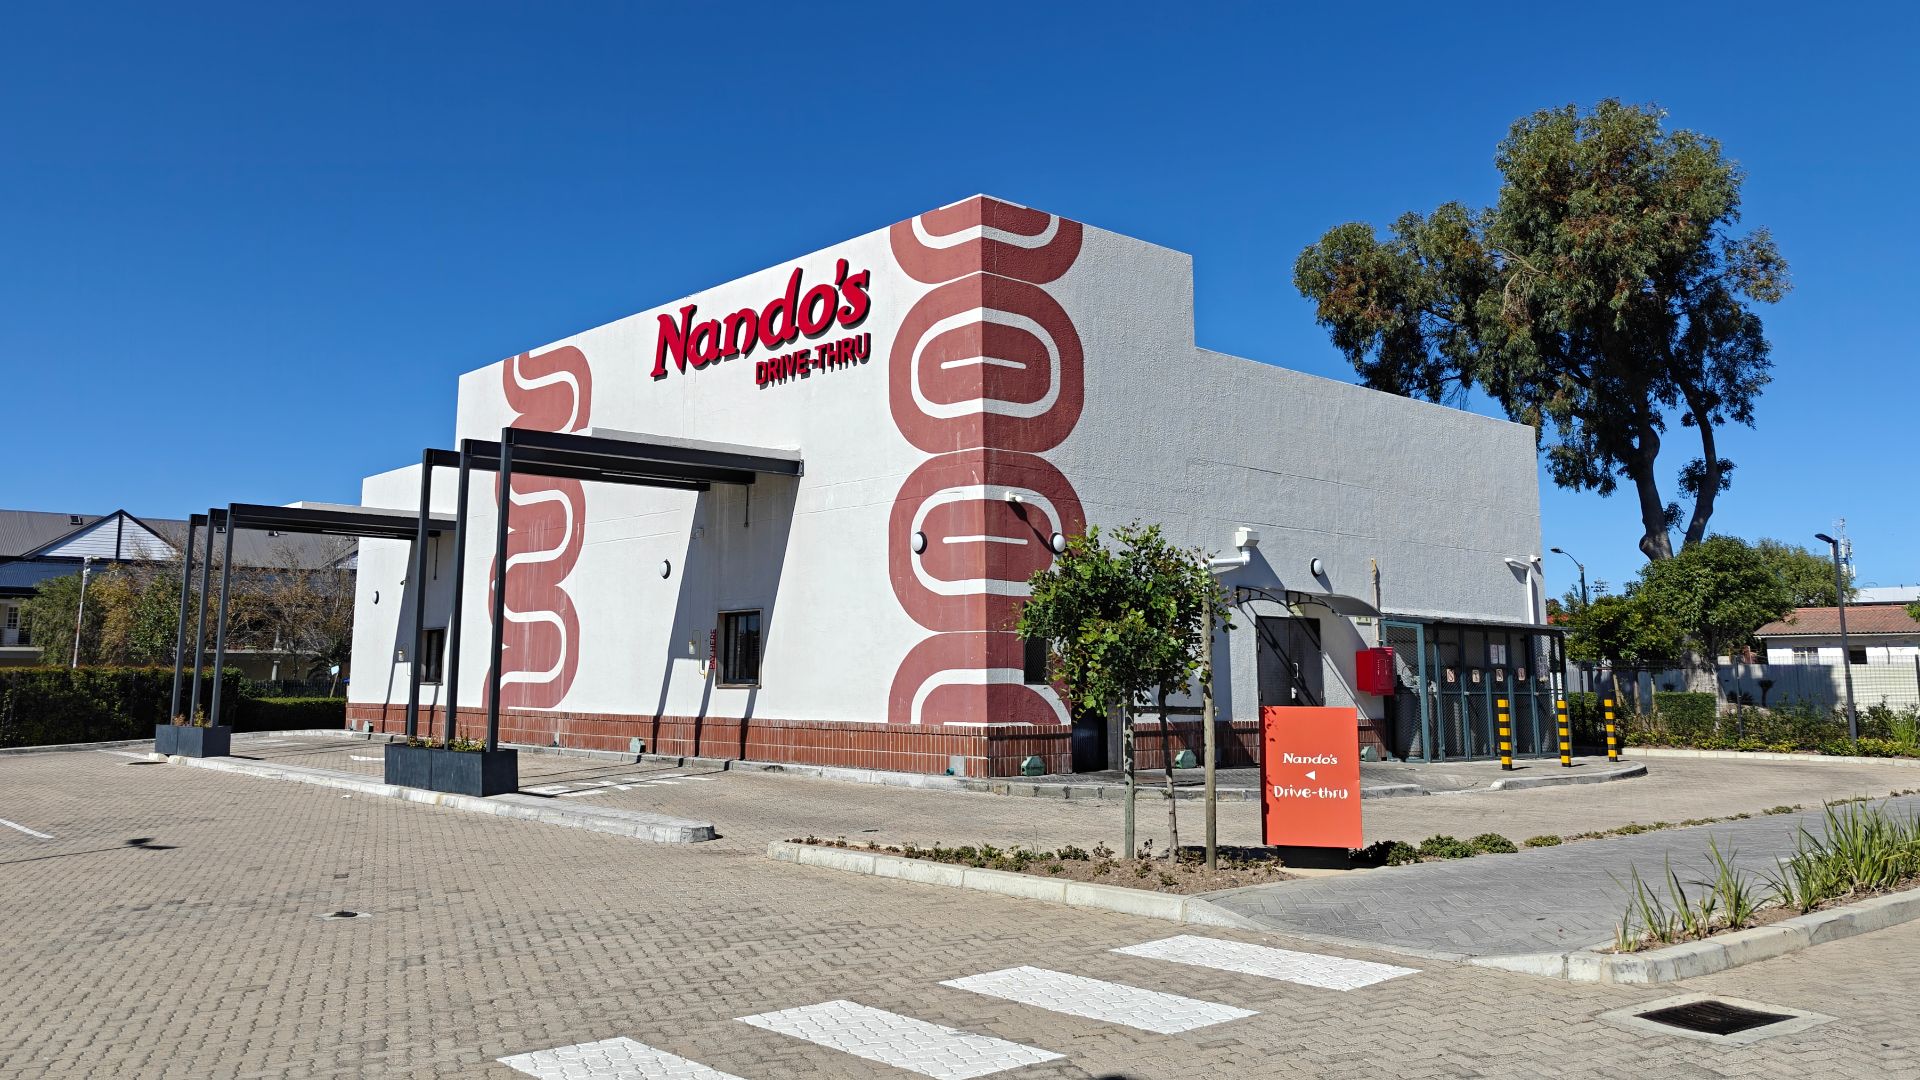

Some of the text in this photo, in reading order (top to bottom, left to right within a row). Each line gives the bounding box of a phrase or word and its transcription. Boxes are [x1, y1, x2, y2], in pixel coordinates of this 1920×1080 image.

[650, 258, 871, 379] Nando's
[756, 332, 871, 388] DRIVE-THRU
[709, 628, 717, 653] HERE
[1282, 752, 1338, 765] Nando's
[1273, 784, 1348, 799] Drive-thru
